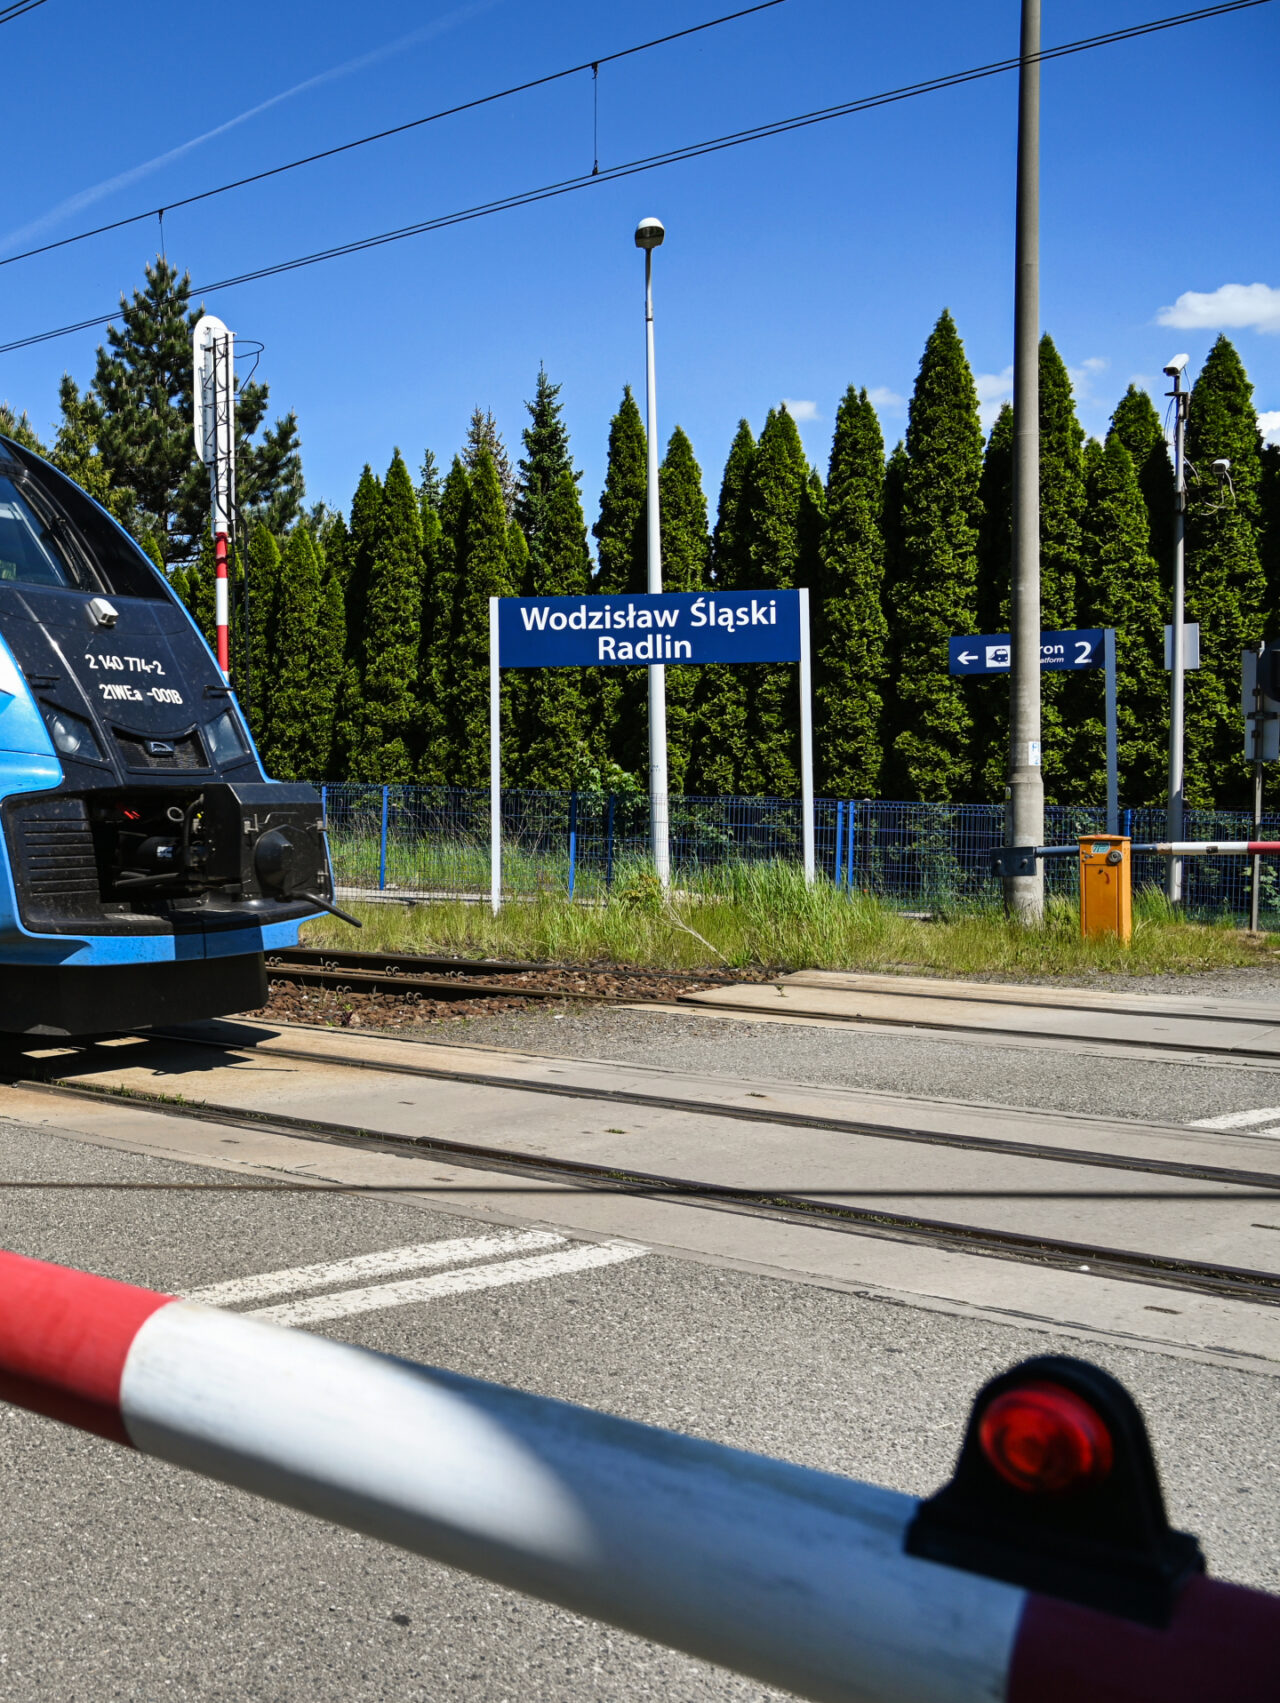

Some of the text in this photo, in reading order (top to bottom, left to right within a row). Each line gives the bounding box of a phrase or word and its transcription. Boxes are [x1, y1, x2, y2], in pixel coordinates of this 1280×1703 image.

[520, 597, 777, 633] Wodzisław Śląski
[598, 634, 692, 660] Radlin
[1074, 641, 1092, 664] 2
[85, 654, 166, 675] 2 140 774-2
